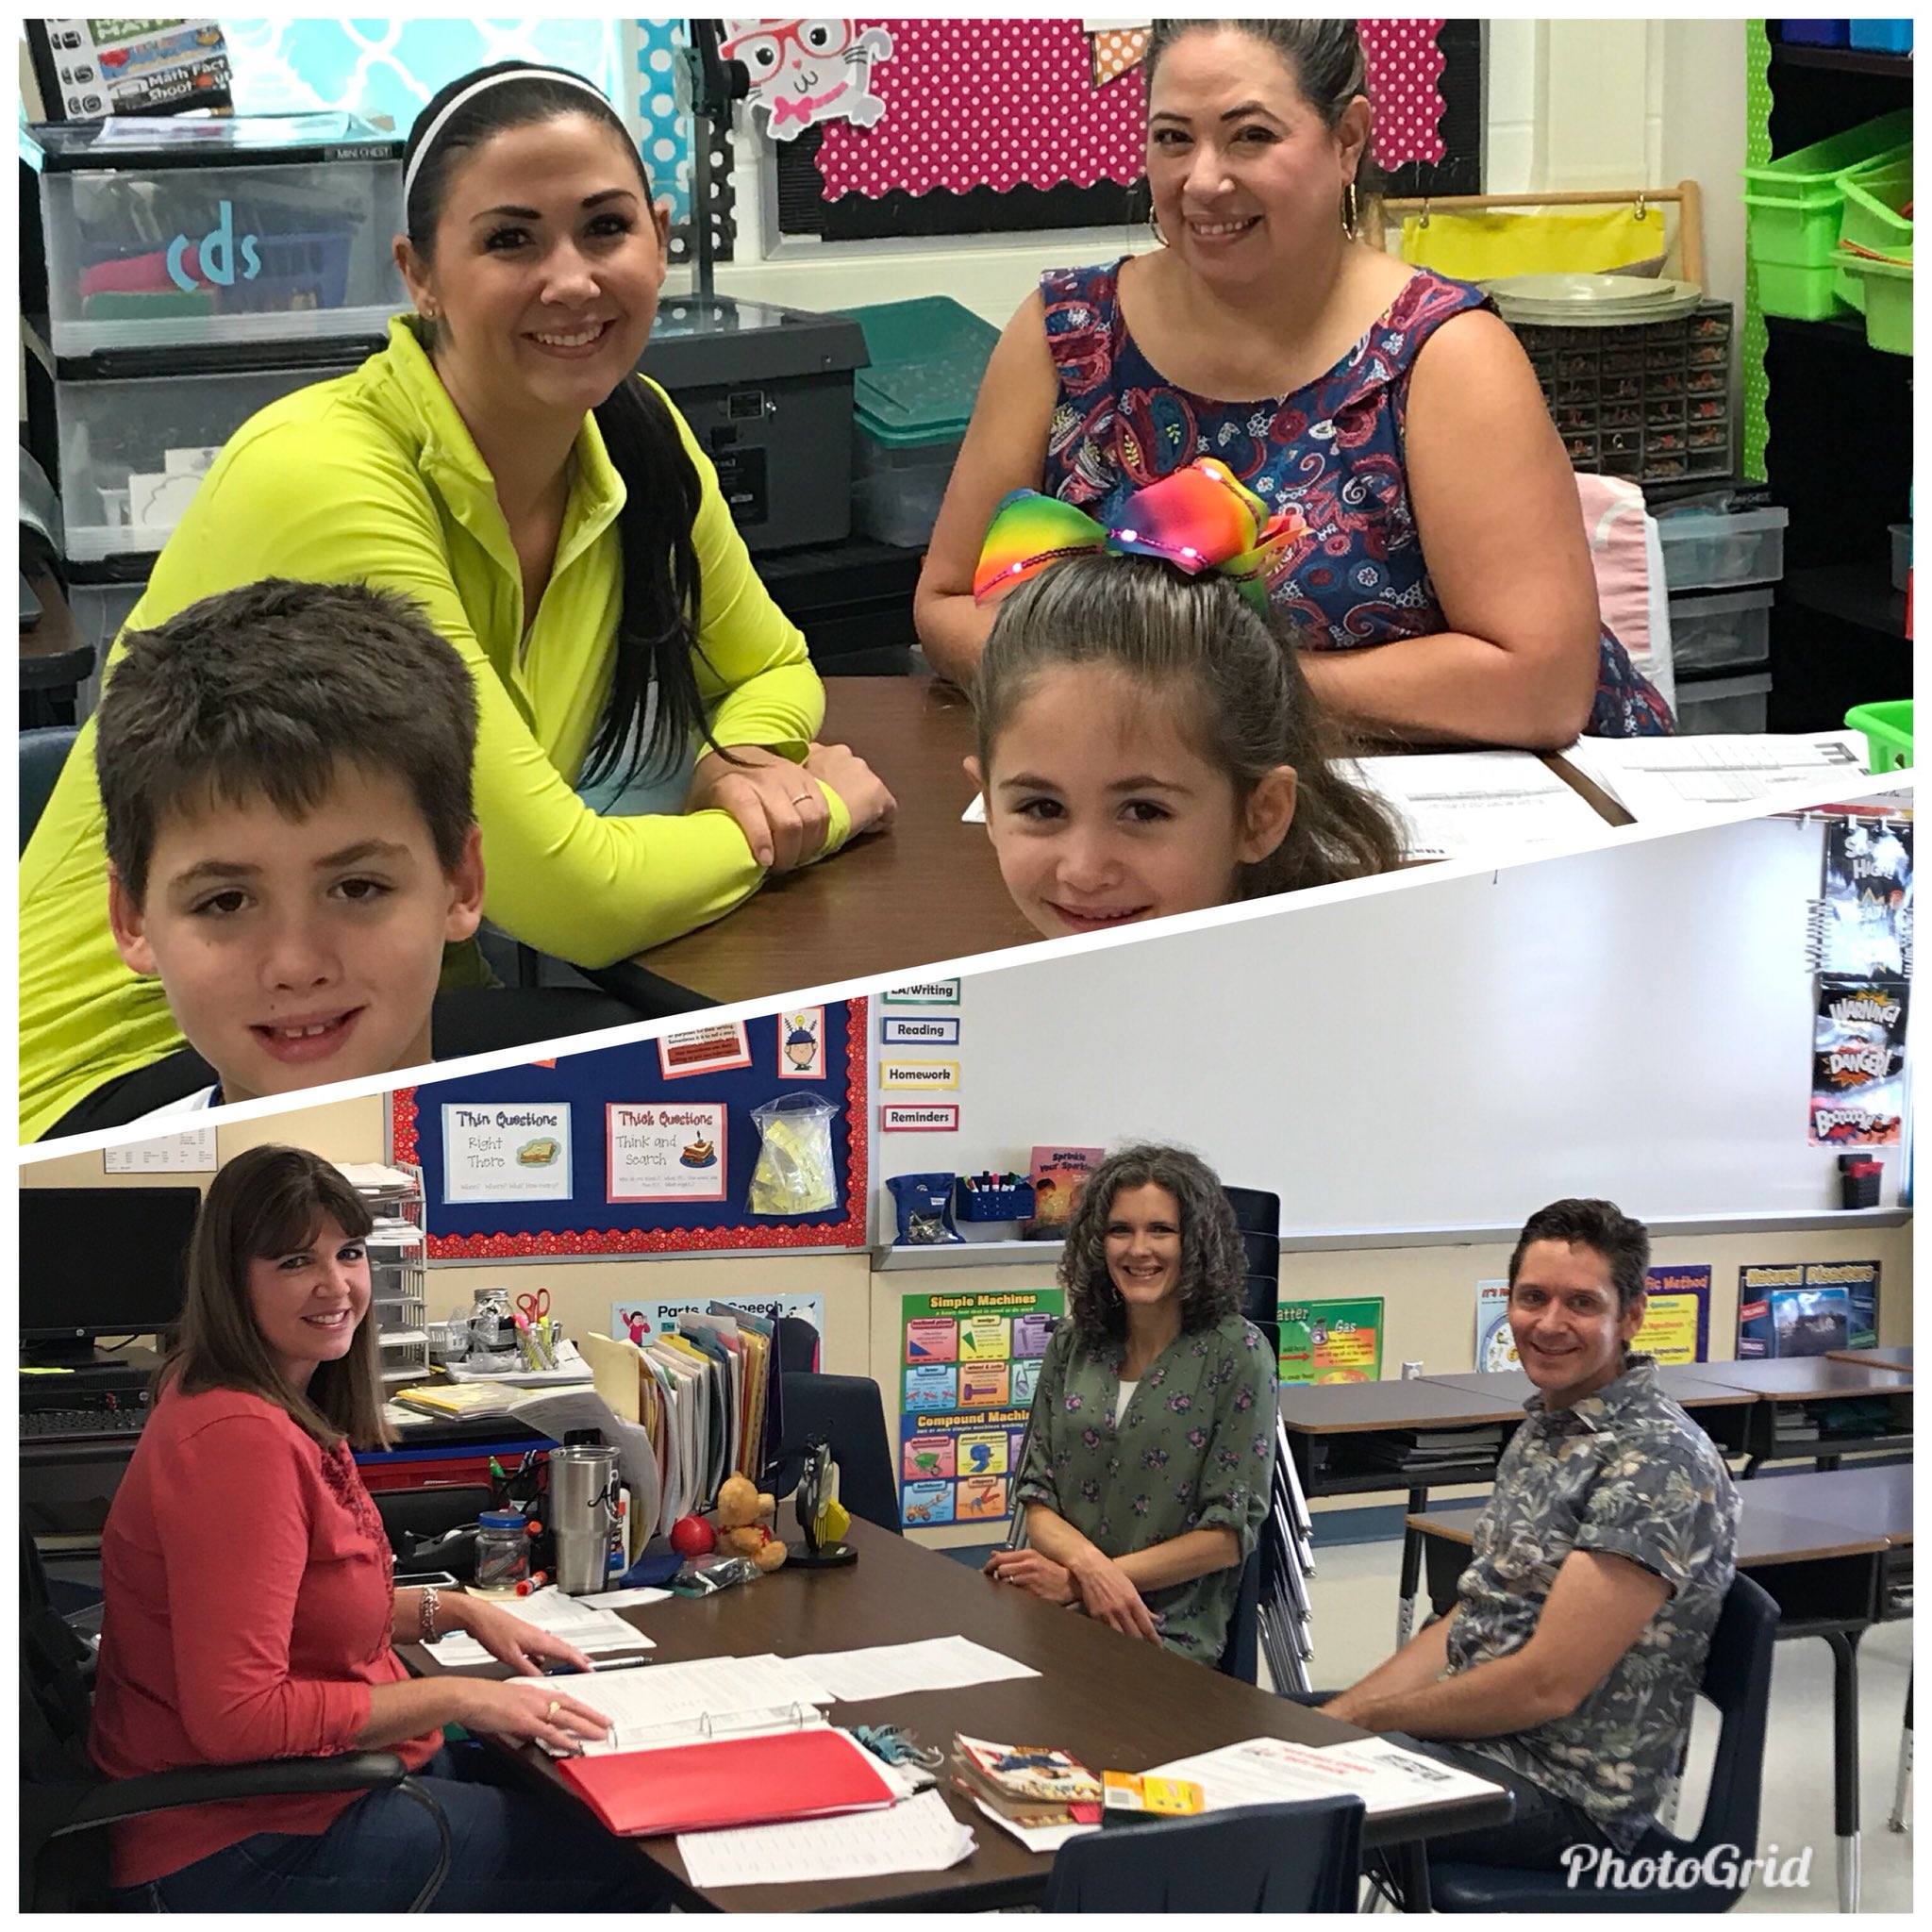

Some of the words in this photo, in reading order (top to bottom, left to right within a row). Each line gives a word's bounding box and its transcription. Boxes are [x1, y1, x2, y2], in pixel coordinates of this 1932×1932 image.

[148, 69, 190, 87] Math
[192, 58, 225, 75] Fact
[166, 199, 262, 293] cds
[1828, 997, 1902, 1028] WARNING!
[898, 1024, 944, 1037] Reading
[890, 1068, 951, 1080] Homework
[456, 1110, 491, 1127] Thin
[495, 1110, 558, 1128] Questions
[618, 1110, 655, 1126] Thick
[658, 1110, 713, 1127] Questions
[891, 1111, 950, 1123] Reminders
[468, 1135, 504, 1151] Right
[616, 1135, 651, 1148] Think
[654, 1135, 676, 1148] and
[467, 1155, 506, 1169] There
[1663, 1275, 1708, 1290] Method
[1746, 1266, 1805, 1287] Natural
[1806, 1265, 1874, 1285] Disasters
[930, 1295, 974, 1309] Simple
[977, 1293, 1037, 1307] Machines
[658, 1304, 699, 1319] Parts
[1276, 1308, 1309, 1321] atter
[1335, 1319, 1357, 1334] Gas
[918, 1413, 985, 1428] Compound
